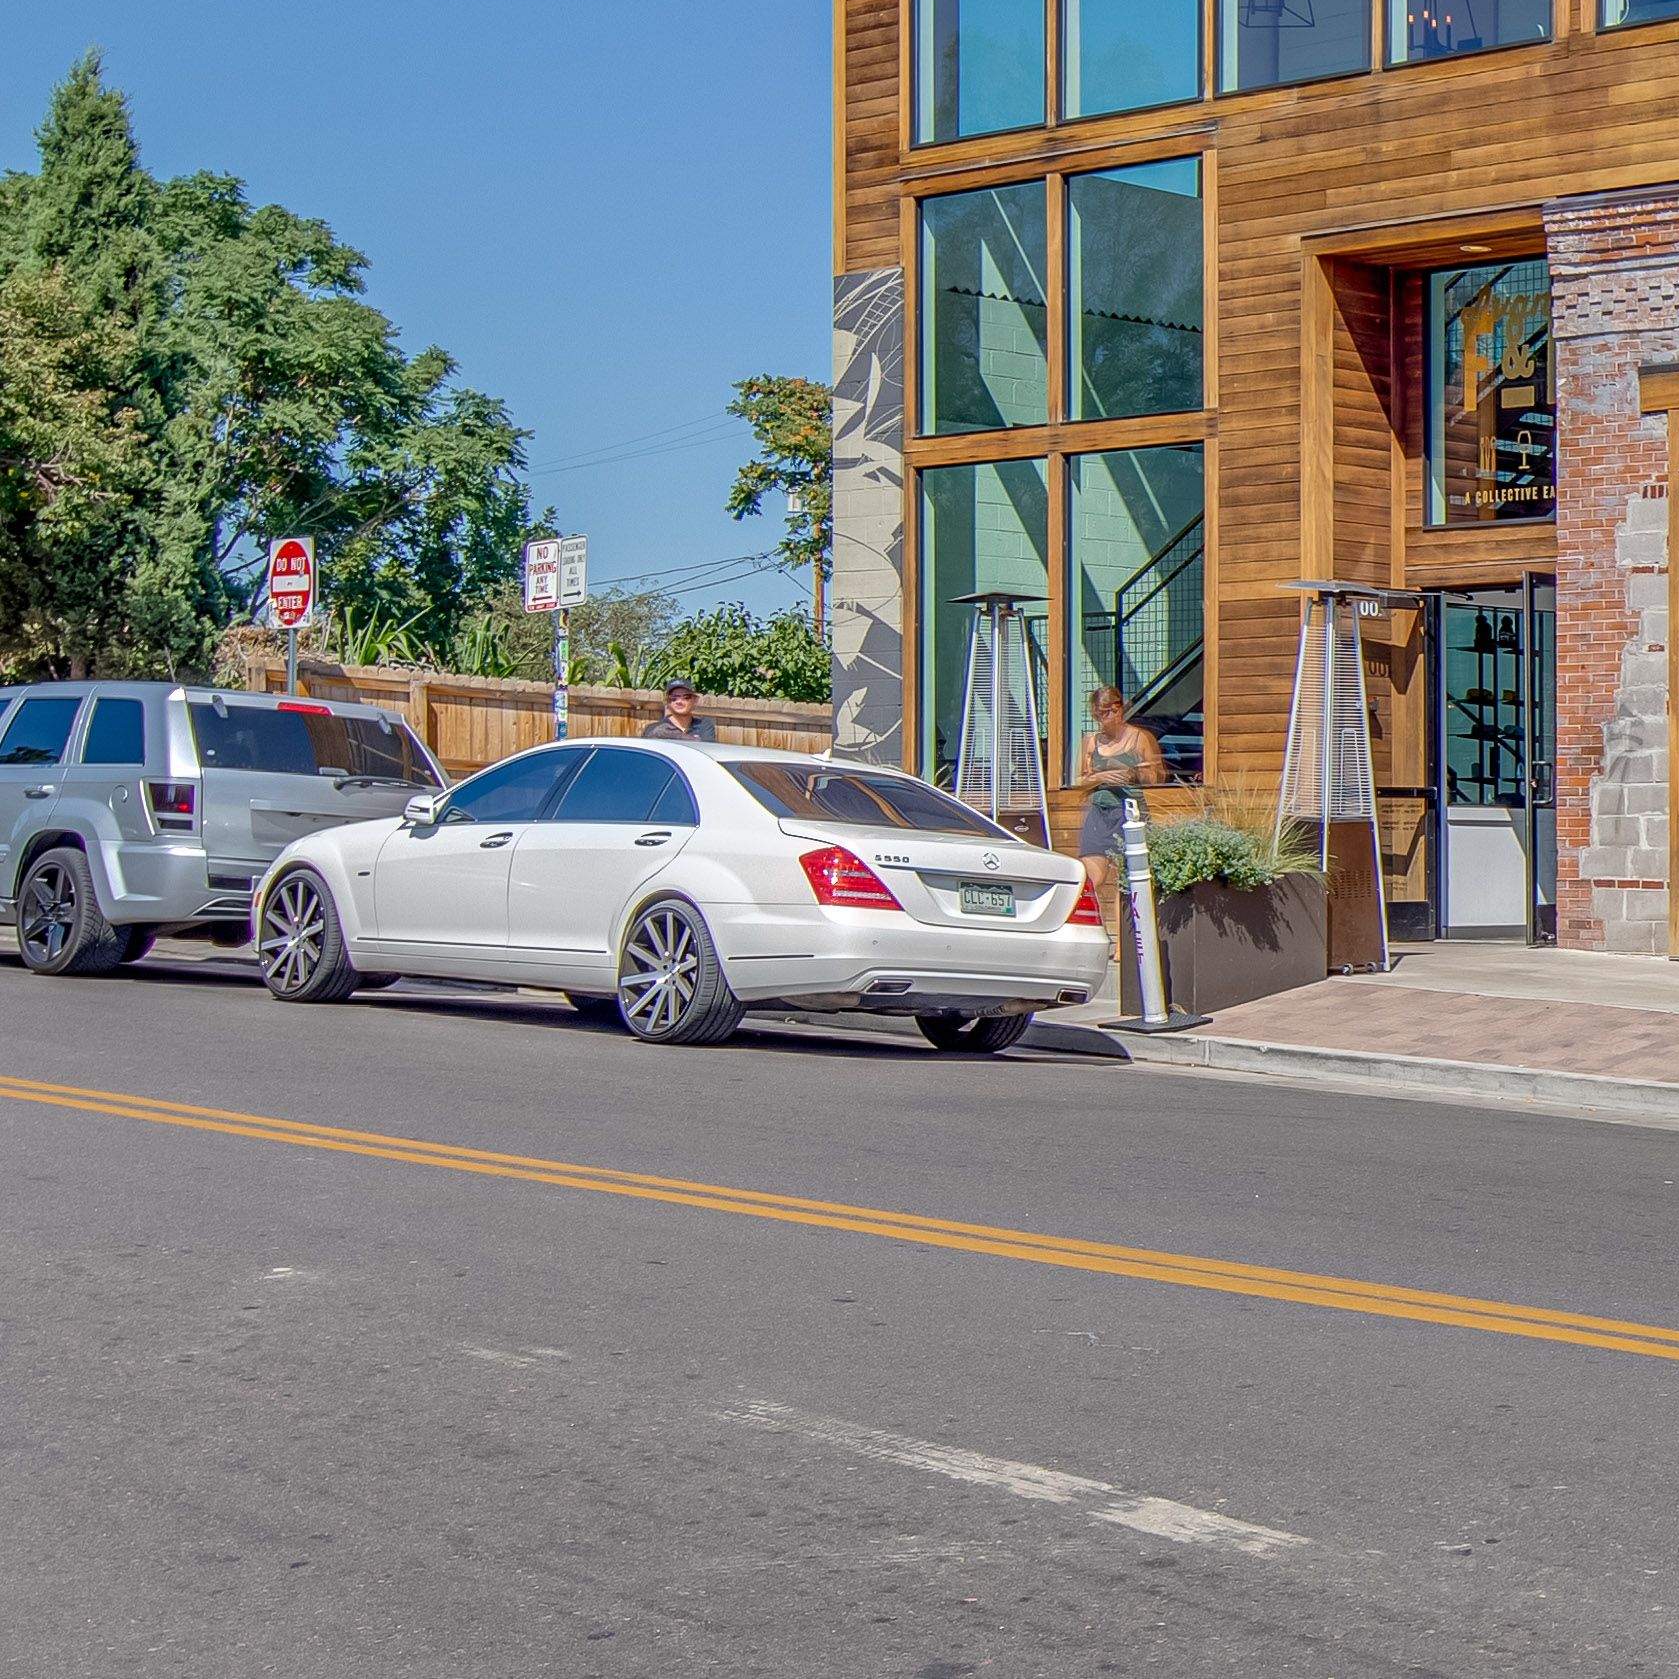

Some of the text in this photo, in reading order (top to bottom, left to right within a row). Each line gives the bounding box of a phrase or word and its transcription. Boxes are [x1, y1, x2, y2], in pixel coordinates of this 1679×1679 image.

[1465, 492, 1471, 505] A
[1475, 487, 1539, 505] COLLECTIVE
[537, 546, 549, 560] NO
[276, 556, 306, 572] DO NOT
[528, 561, 557, 576] PARKING
[536, 575, 548, 584] ANY
